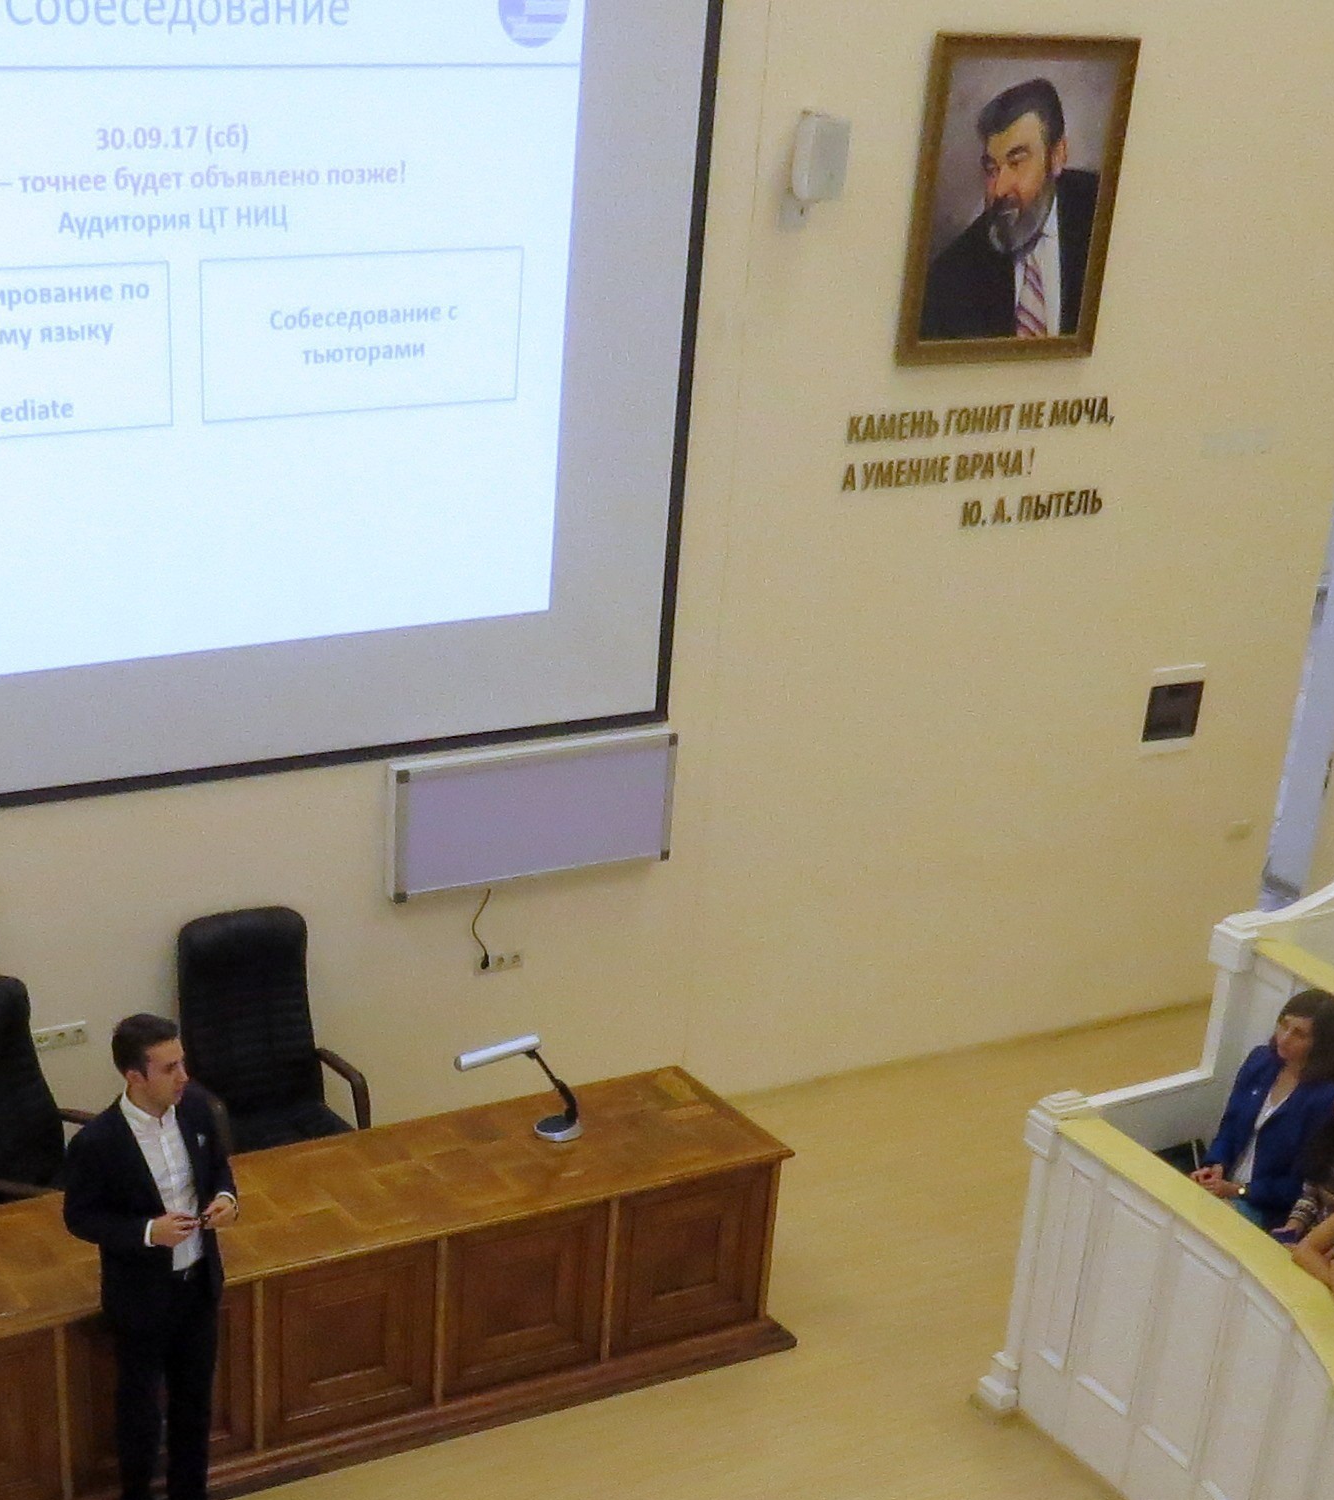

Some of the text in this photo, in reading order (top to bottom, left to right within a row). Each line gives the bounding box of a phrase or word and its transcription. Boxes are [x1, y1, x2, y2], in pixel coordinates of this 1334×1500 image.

[96, 123, 249, 153] 30.09.17 (сб)
[20, 174, 106, 193] точнее
[114, 166, 183, 197] будет
[190, 163, 320, 189] объявлено
[327, 160, 407, 185] позже!
[58, 204, 288, 239] Аудитория ЦТ НИЦ
[120, 282, 150, 301] по
[40, 322, 114, 346] языку
[269, 304, 459, 333] Собеседование с
[302, 341, 425, 366] тьюторами
[846, 396, 1115, 443] КАМЕНЬ ГОНИТ НЕ МОЧА,
[841, 462, 857, 492] А
[861, 455, 951, 491] УМЕНИЕ
[960, 488, 1103, 527] Ю. А. ПЫТЕЛЬ
